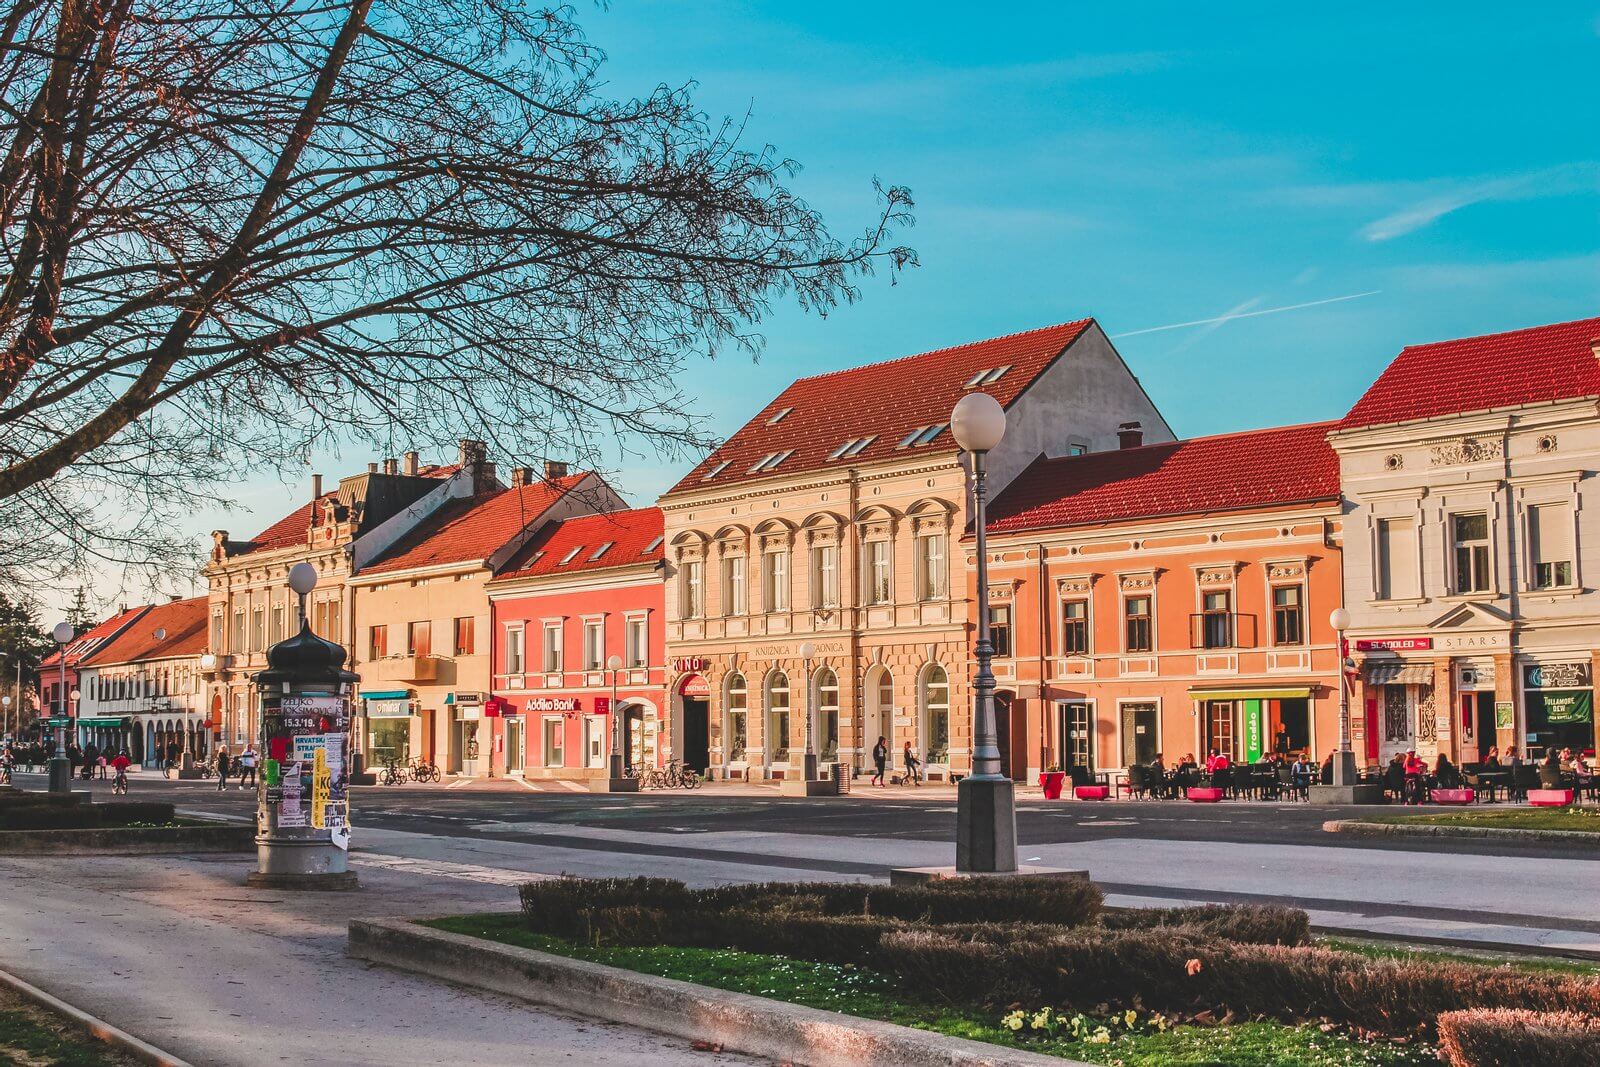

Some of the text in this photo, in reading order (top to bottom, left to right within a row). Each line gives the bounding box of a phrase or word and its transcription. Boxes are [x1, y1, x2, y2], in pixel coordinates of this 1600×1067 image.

[1446, 636, 1497, 647] STARS
[672, 657, 699, 671] KINO
[526, 697, 574, 711] Addiko Bank
[1248, 712, 1257, 751] froddo
